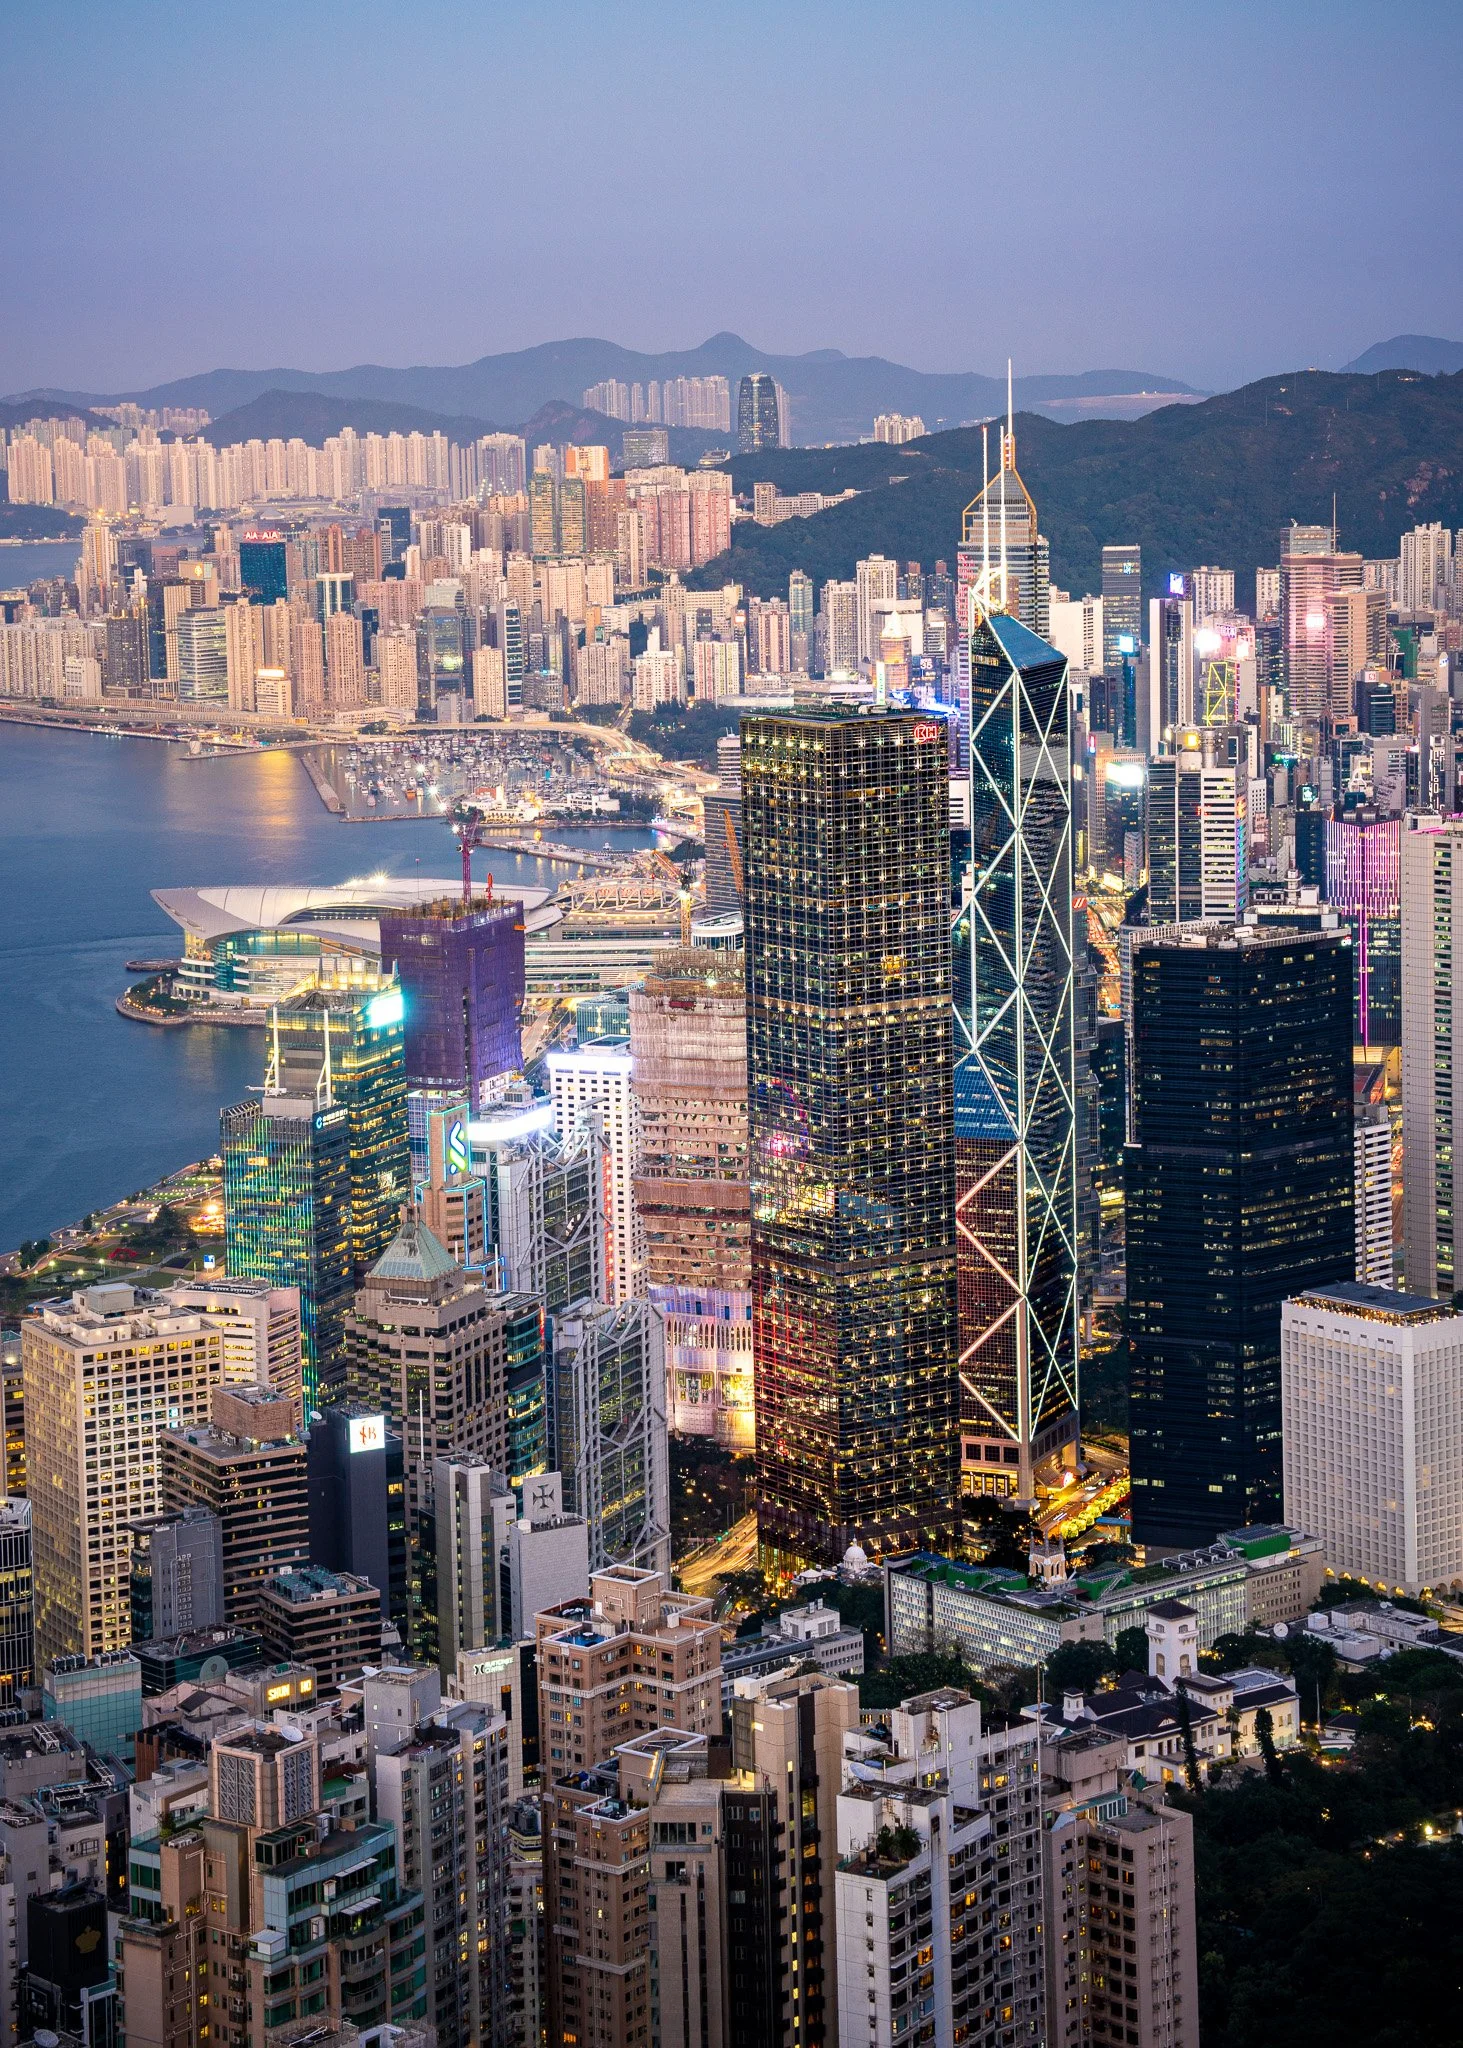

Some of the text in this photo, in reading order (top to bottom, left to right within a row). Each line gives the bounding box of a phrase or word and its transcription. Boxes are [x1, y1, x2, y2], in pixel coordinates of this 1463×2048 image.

[245, 531, 258, 540] AIA
[262, 531, 278, 540] AIA
[268, 1679, 312, 1701] SHUN HO
